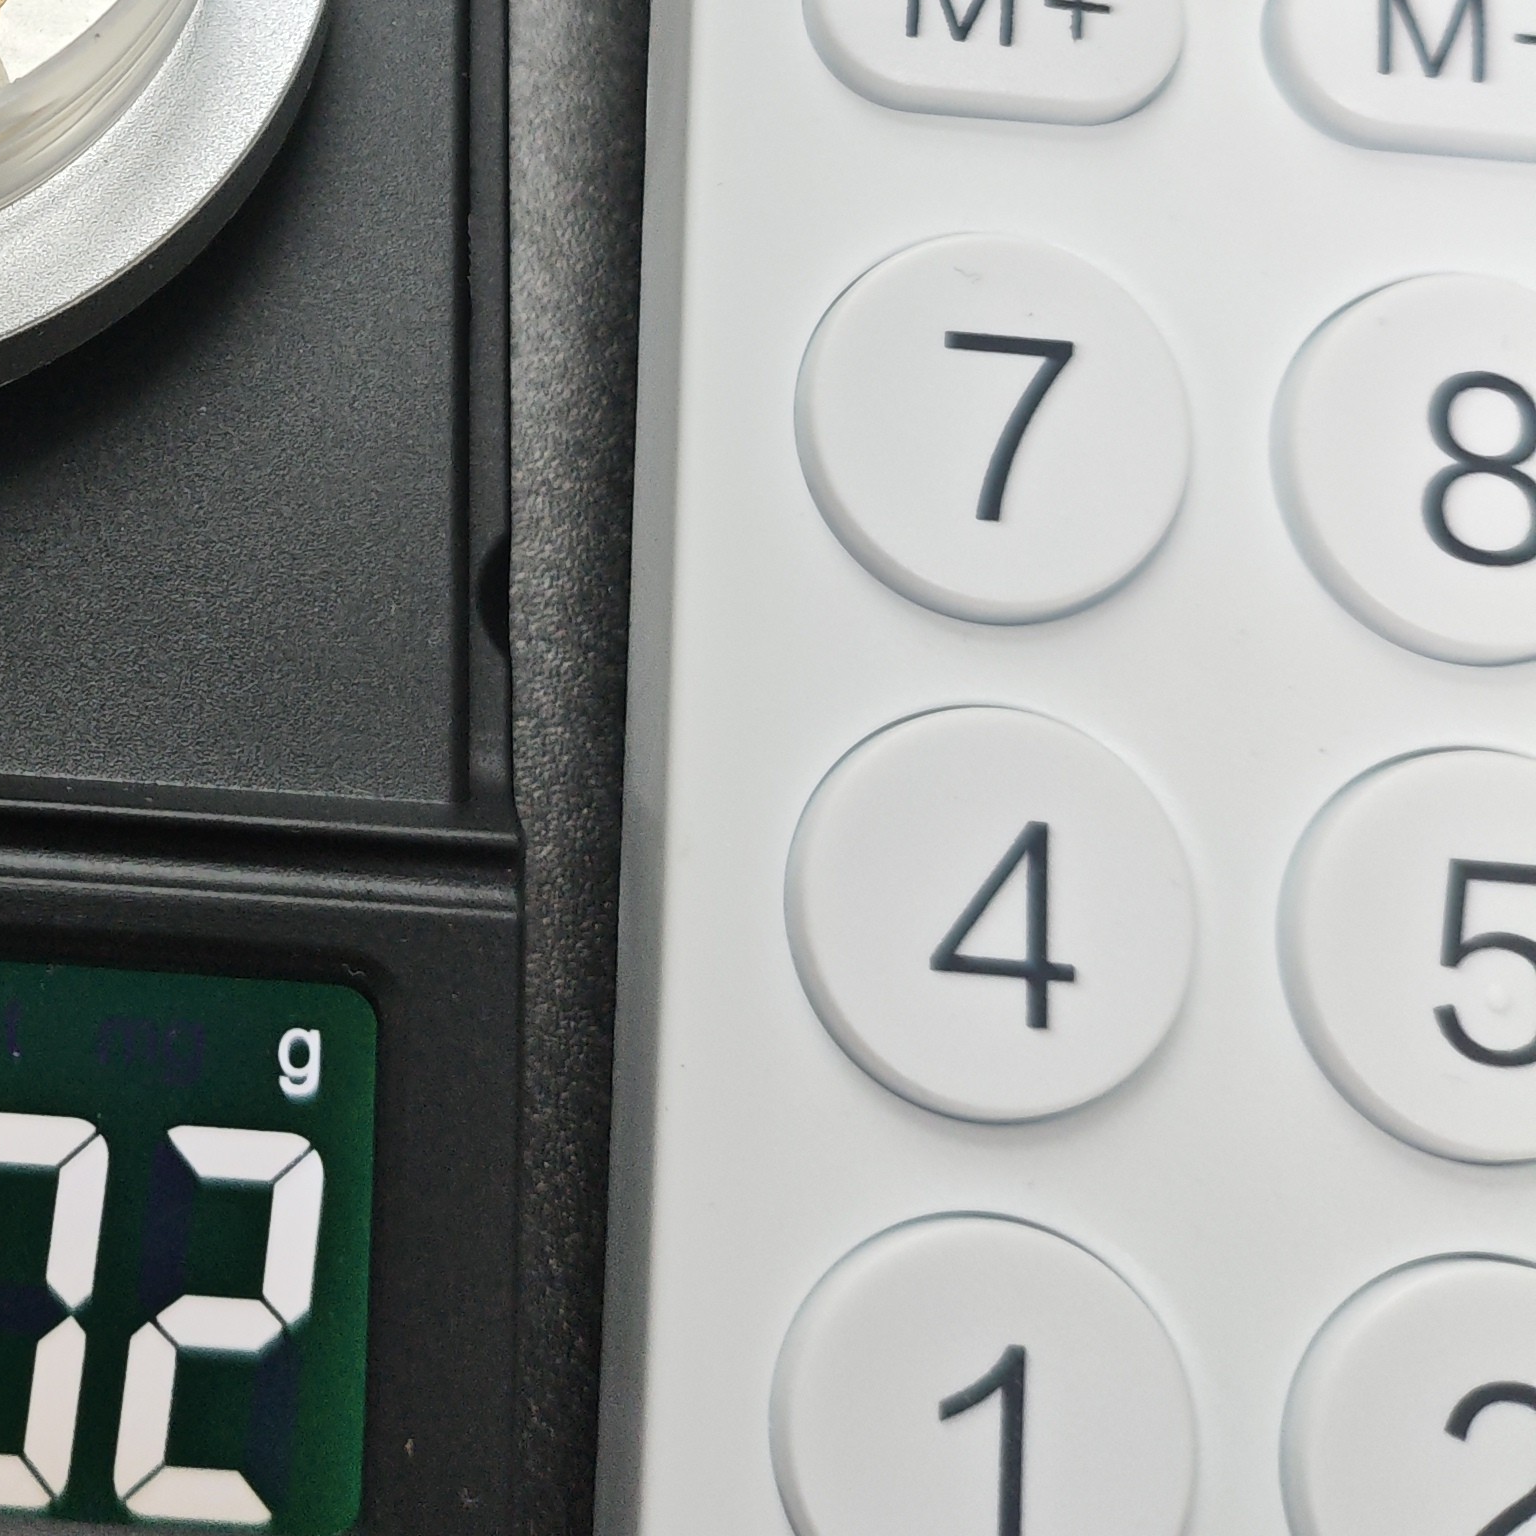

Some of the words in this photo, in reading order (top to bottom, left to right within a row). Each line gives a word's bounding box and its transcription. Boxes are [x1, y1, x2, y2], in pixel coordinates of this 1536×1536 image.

[944, 331, 1073, 521] 7
[1421, 370, 1536, 567] 8
[929, 821, 1076, 1029] 4
[1433, 858, 1536, 1067] 5
[277, 1027, 322, 1102] g
[939, 1345, 1026, 1536] 1
